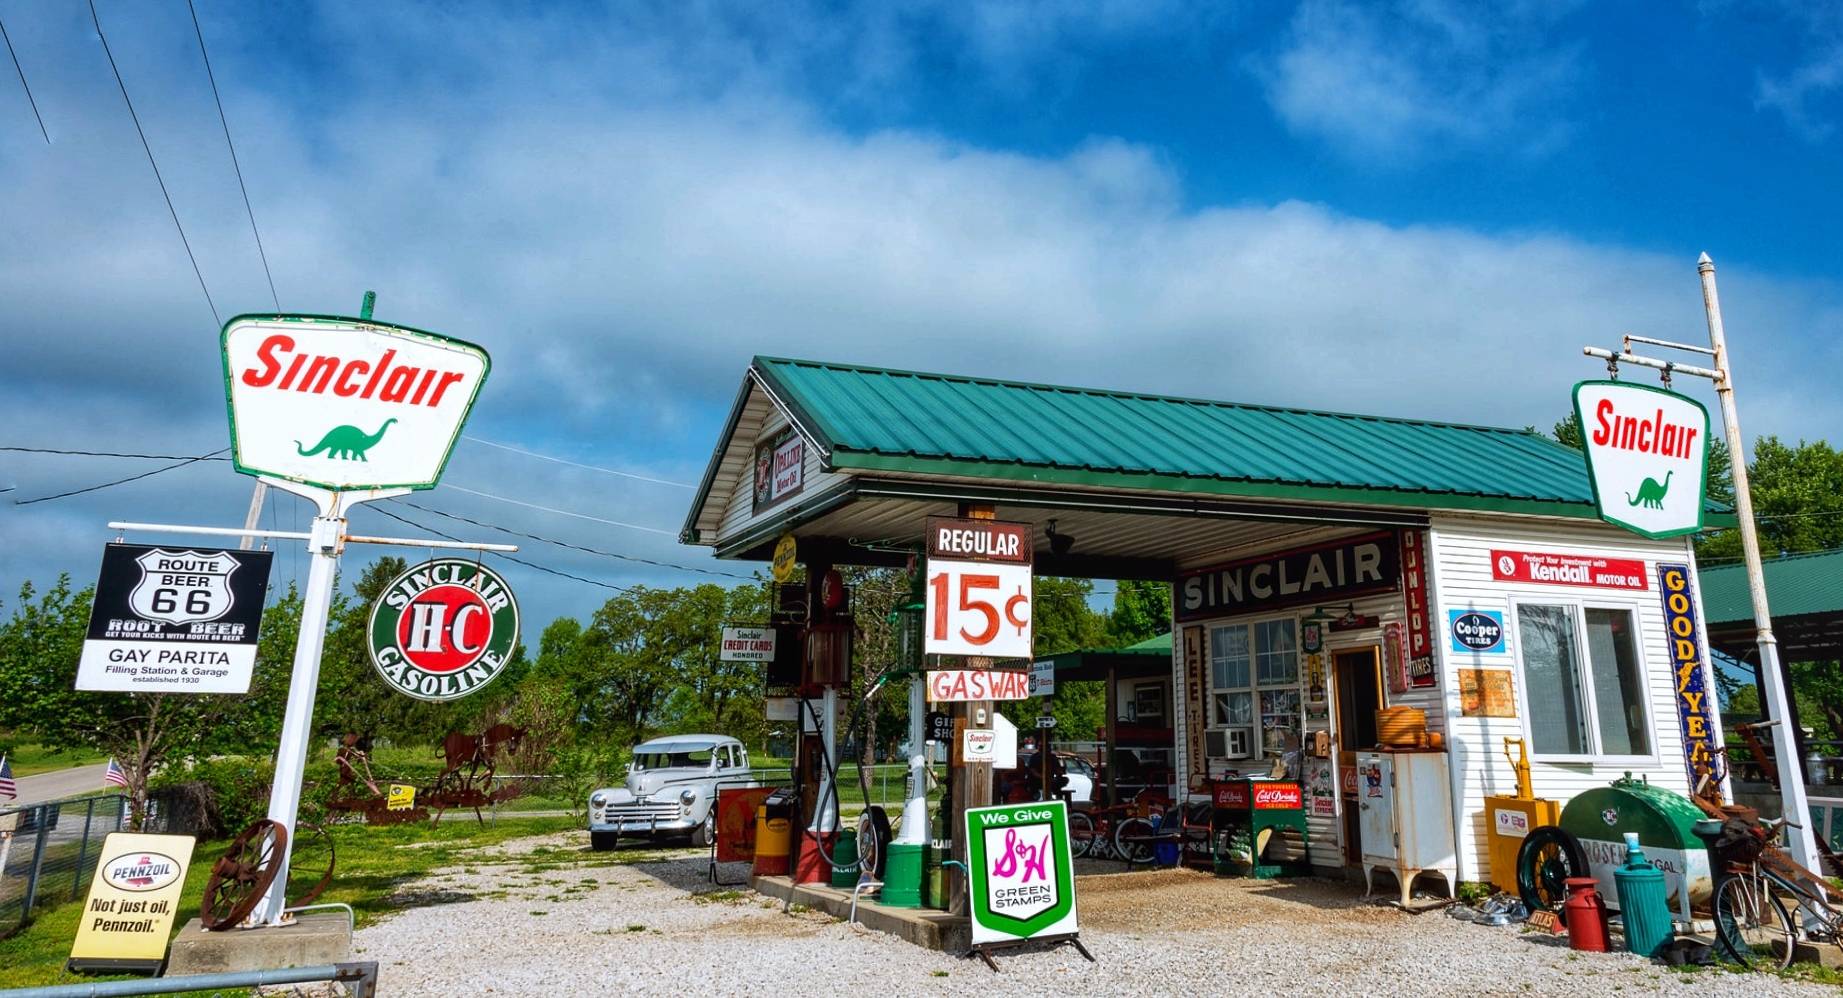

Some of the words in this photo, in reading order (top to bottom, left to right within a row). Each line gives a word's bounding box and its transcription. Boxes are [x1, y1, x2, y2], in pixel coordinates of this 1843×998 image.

[242, 334, 464, 407] Sinclair
[1593, 398, 1697, 459] Sinclair
[938, 528, 1020, 556] REGULAR
[157, 558, 220, 573] ROUTE
[1592, 559, 1608, 568] with
[160, 574, 211, 588] BEER
[1184, 543, 1383, 611] SINCLAIR
[1529, 562, 1590, 584] Kendall
[1596, 574, 1627, 586] MOTOR
[1627, 575, 1642, 587] OIL
[386, 564, 509, 615] SINCLAIR
[1403, 531, 1424, 652] DUNLOP
[150, 588, 213, 616] 66
[929, 571, 1029, 646] 15¢
[107, 618, 167, 633] ROOT
[189, 621, 246, 636] BEER
[407, 603, 484, 655] H-C
[736, 630, 762, 640] Sinclair
[1456, 621, 1498, 637] Cooper
[724, 640, 748, 650] CREDIT
[750, 641, 772, 652] CARDS
[1465, 637, 1491, 645] TIRES
[108, 648, 152, 663] GAY
[157, 649, 231, 665] PARITA
[105, 665, 138, 675] Filling
[140, 666, 177, 675] Station
[180, 667, 188, 675] &
[192, 667, 229, 678] Garage
[377, 646, 505, 696] GASOLINE
[1187, 636, 1199, 702] LEE
[1409, 655, 1432, 679] TIRES
[931, 671, 986, 700] GAS
[988, 671, 1029, 699] WAR
[1664, 570, 1714, 789] GOODYEA
[979, 812, 1010, 825] We
[1013, 809, 1054, 823] Give
[992, 828, 1050, 883] S&H
[112, 863, 171, 880] PENNZOIL
[994, 884, 1051, 899] GREEN
[90, 898, 116, 912] Not
[117, 899, 148, 915] just
[150, 900, 170, 916] oil,
[995, 894, 1052, 909] STAMPS
[1529, 912, 1555, 928] ATLAS
